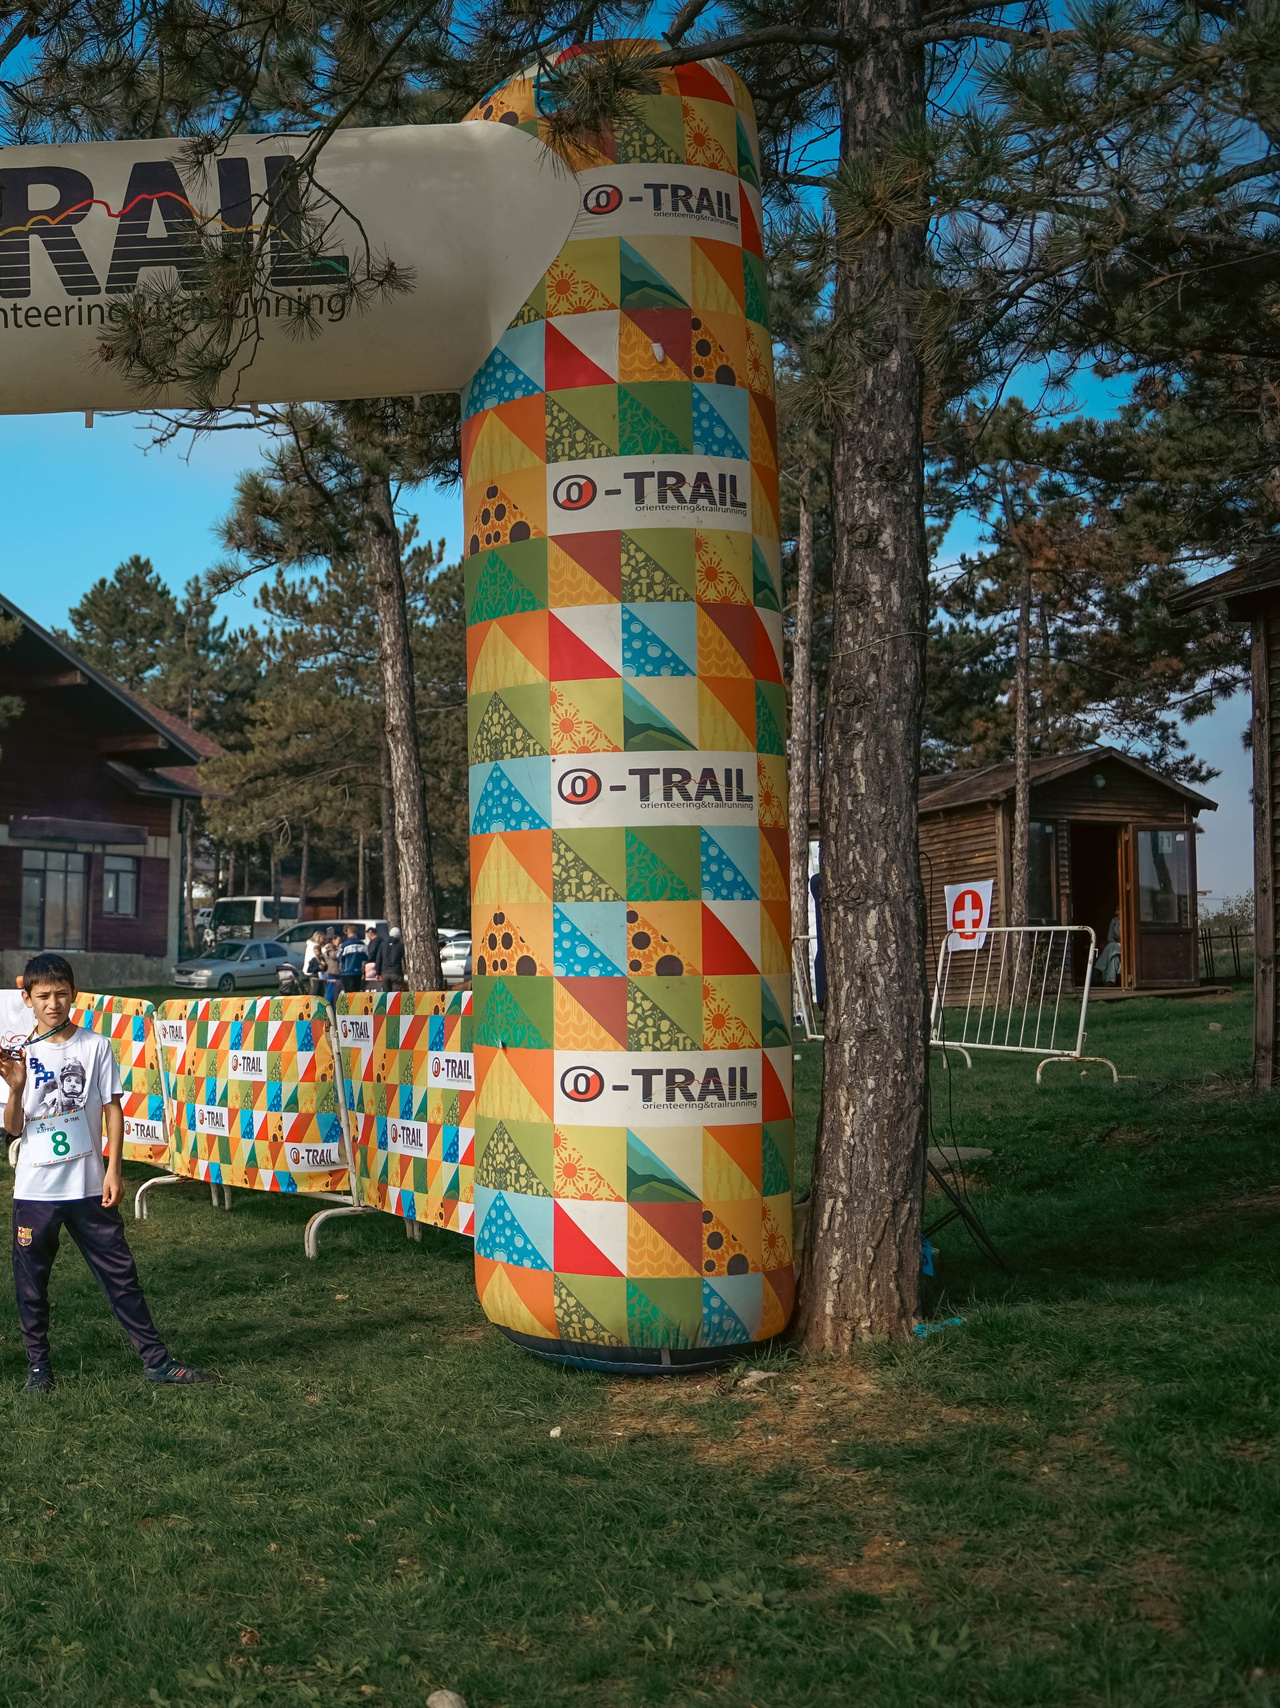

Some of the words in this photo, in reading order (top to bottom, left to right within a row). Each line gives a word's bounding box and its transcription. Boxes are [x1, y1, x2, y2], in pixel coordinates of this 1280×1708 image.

[640, 800, 753, 810] orienteering&trailrunning
[642, 1100, 757, 1111] orienteering&trailrunning
[51, 1131, 71, 1156] 8
